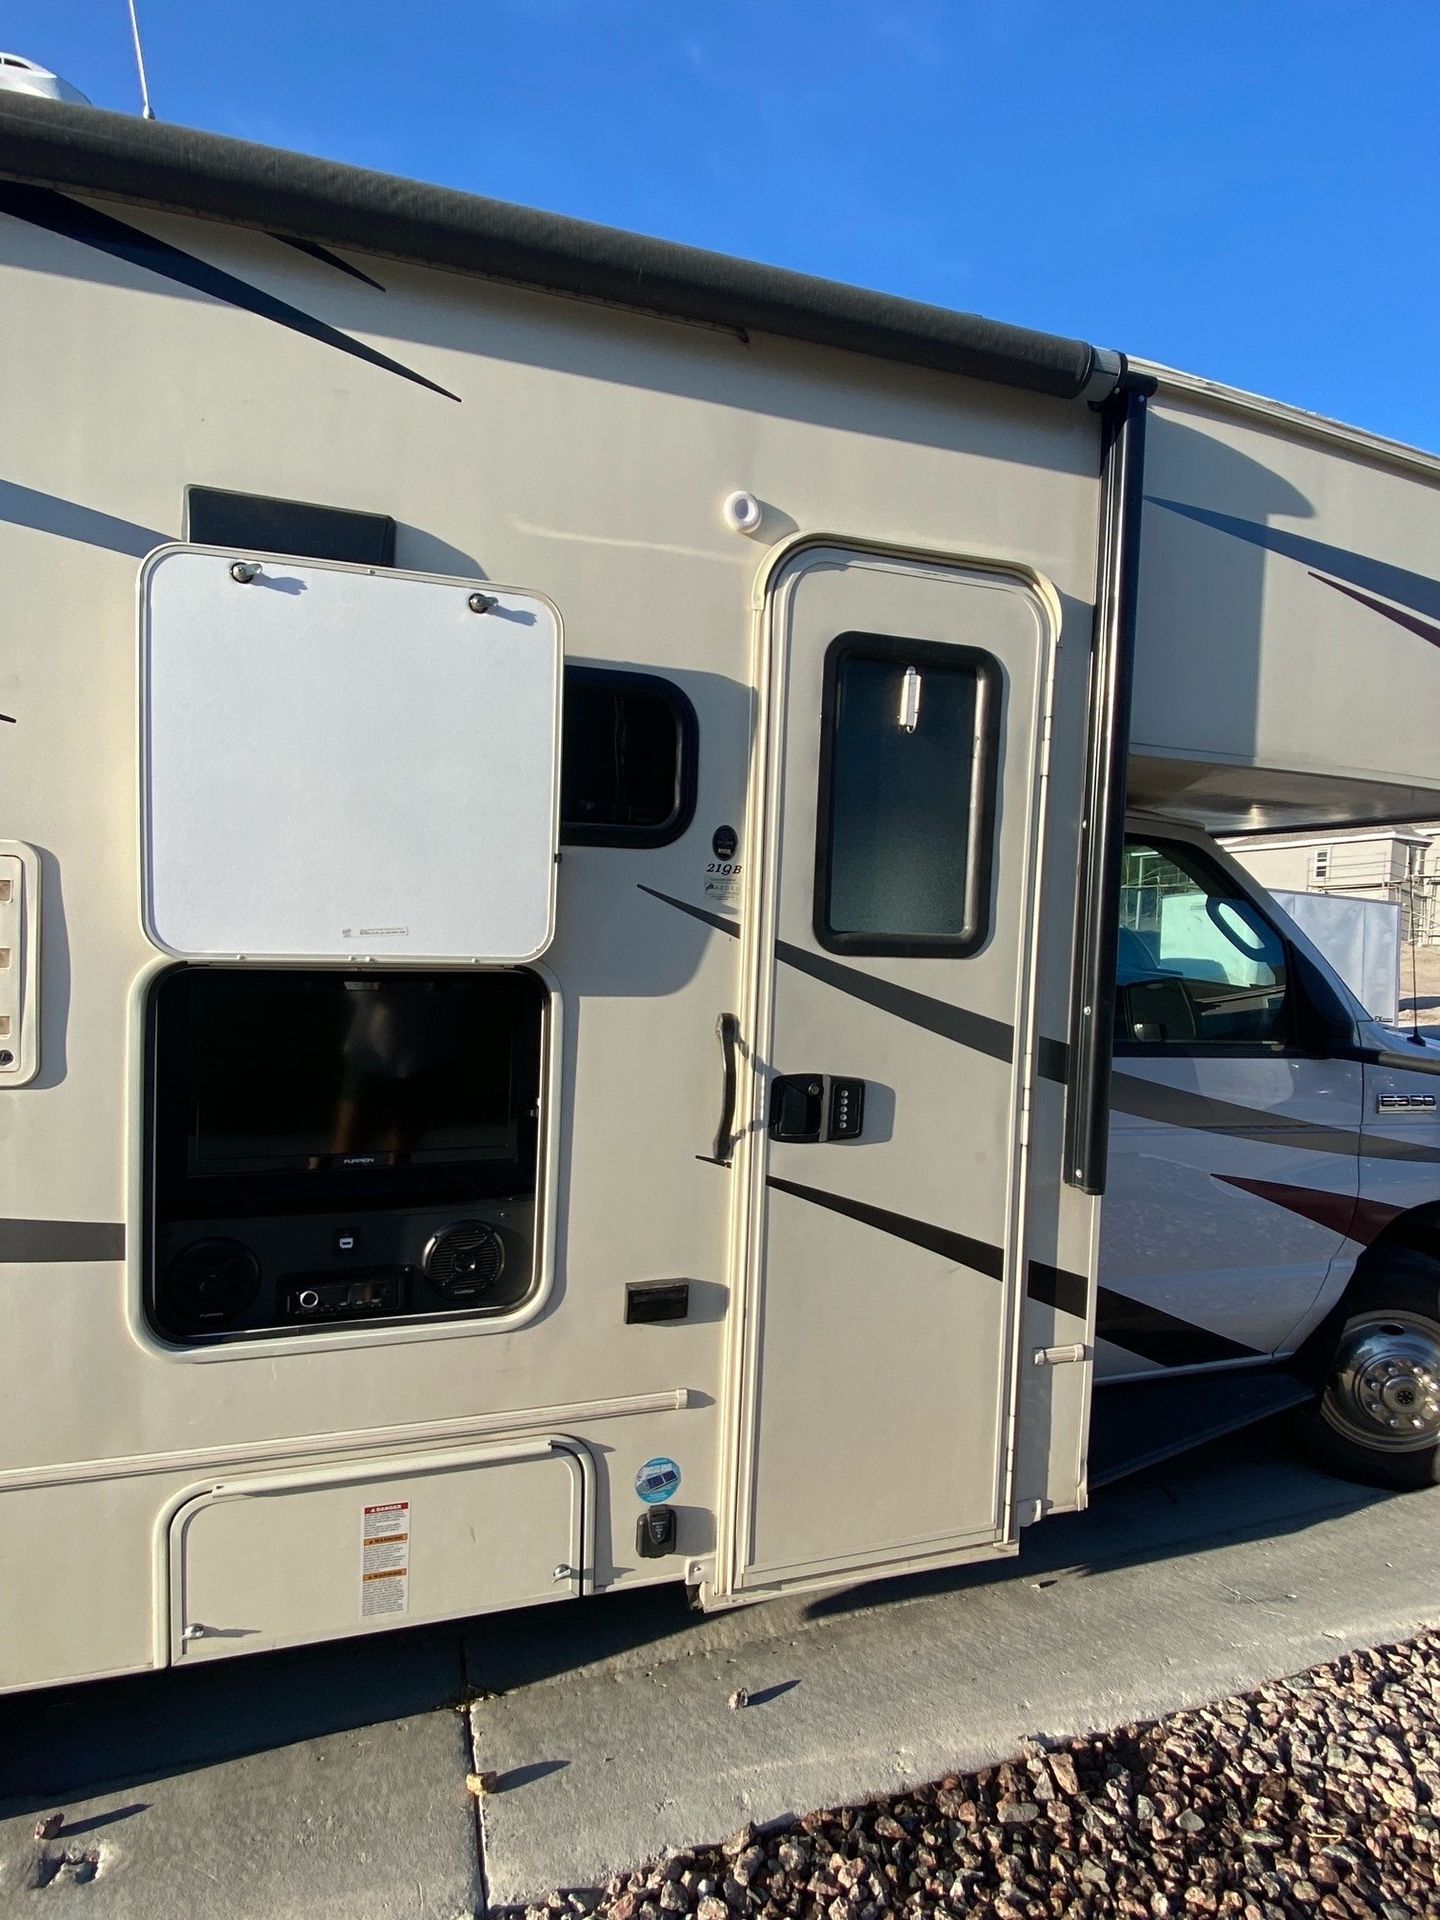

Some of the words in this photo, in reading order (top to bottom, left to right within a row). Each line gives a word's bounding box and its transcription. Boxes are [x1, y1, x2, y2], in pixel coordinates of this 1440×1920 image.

[706, 863, 742, 875] 21QB
[376, 1503, 402, 1512] DANGER
[374, 1535, 403, 1544] WARNING
